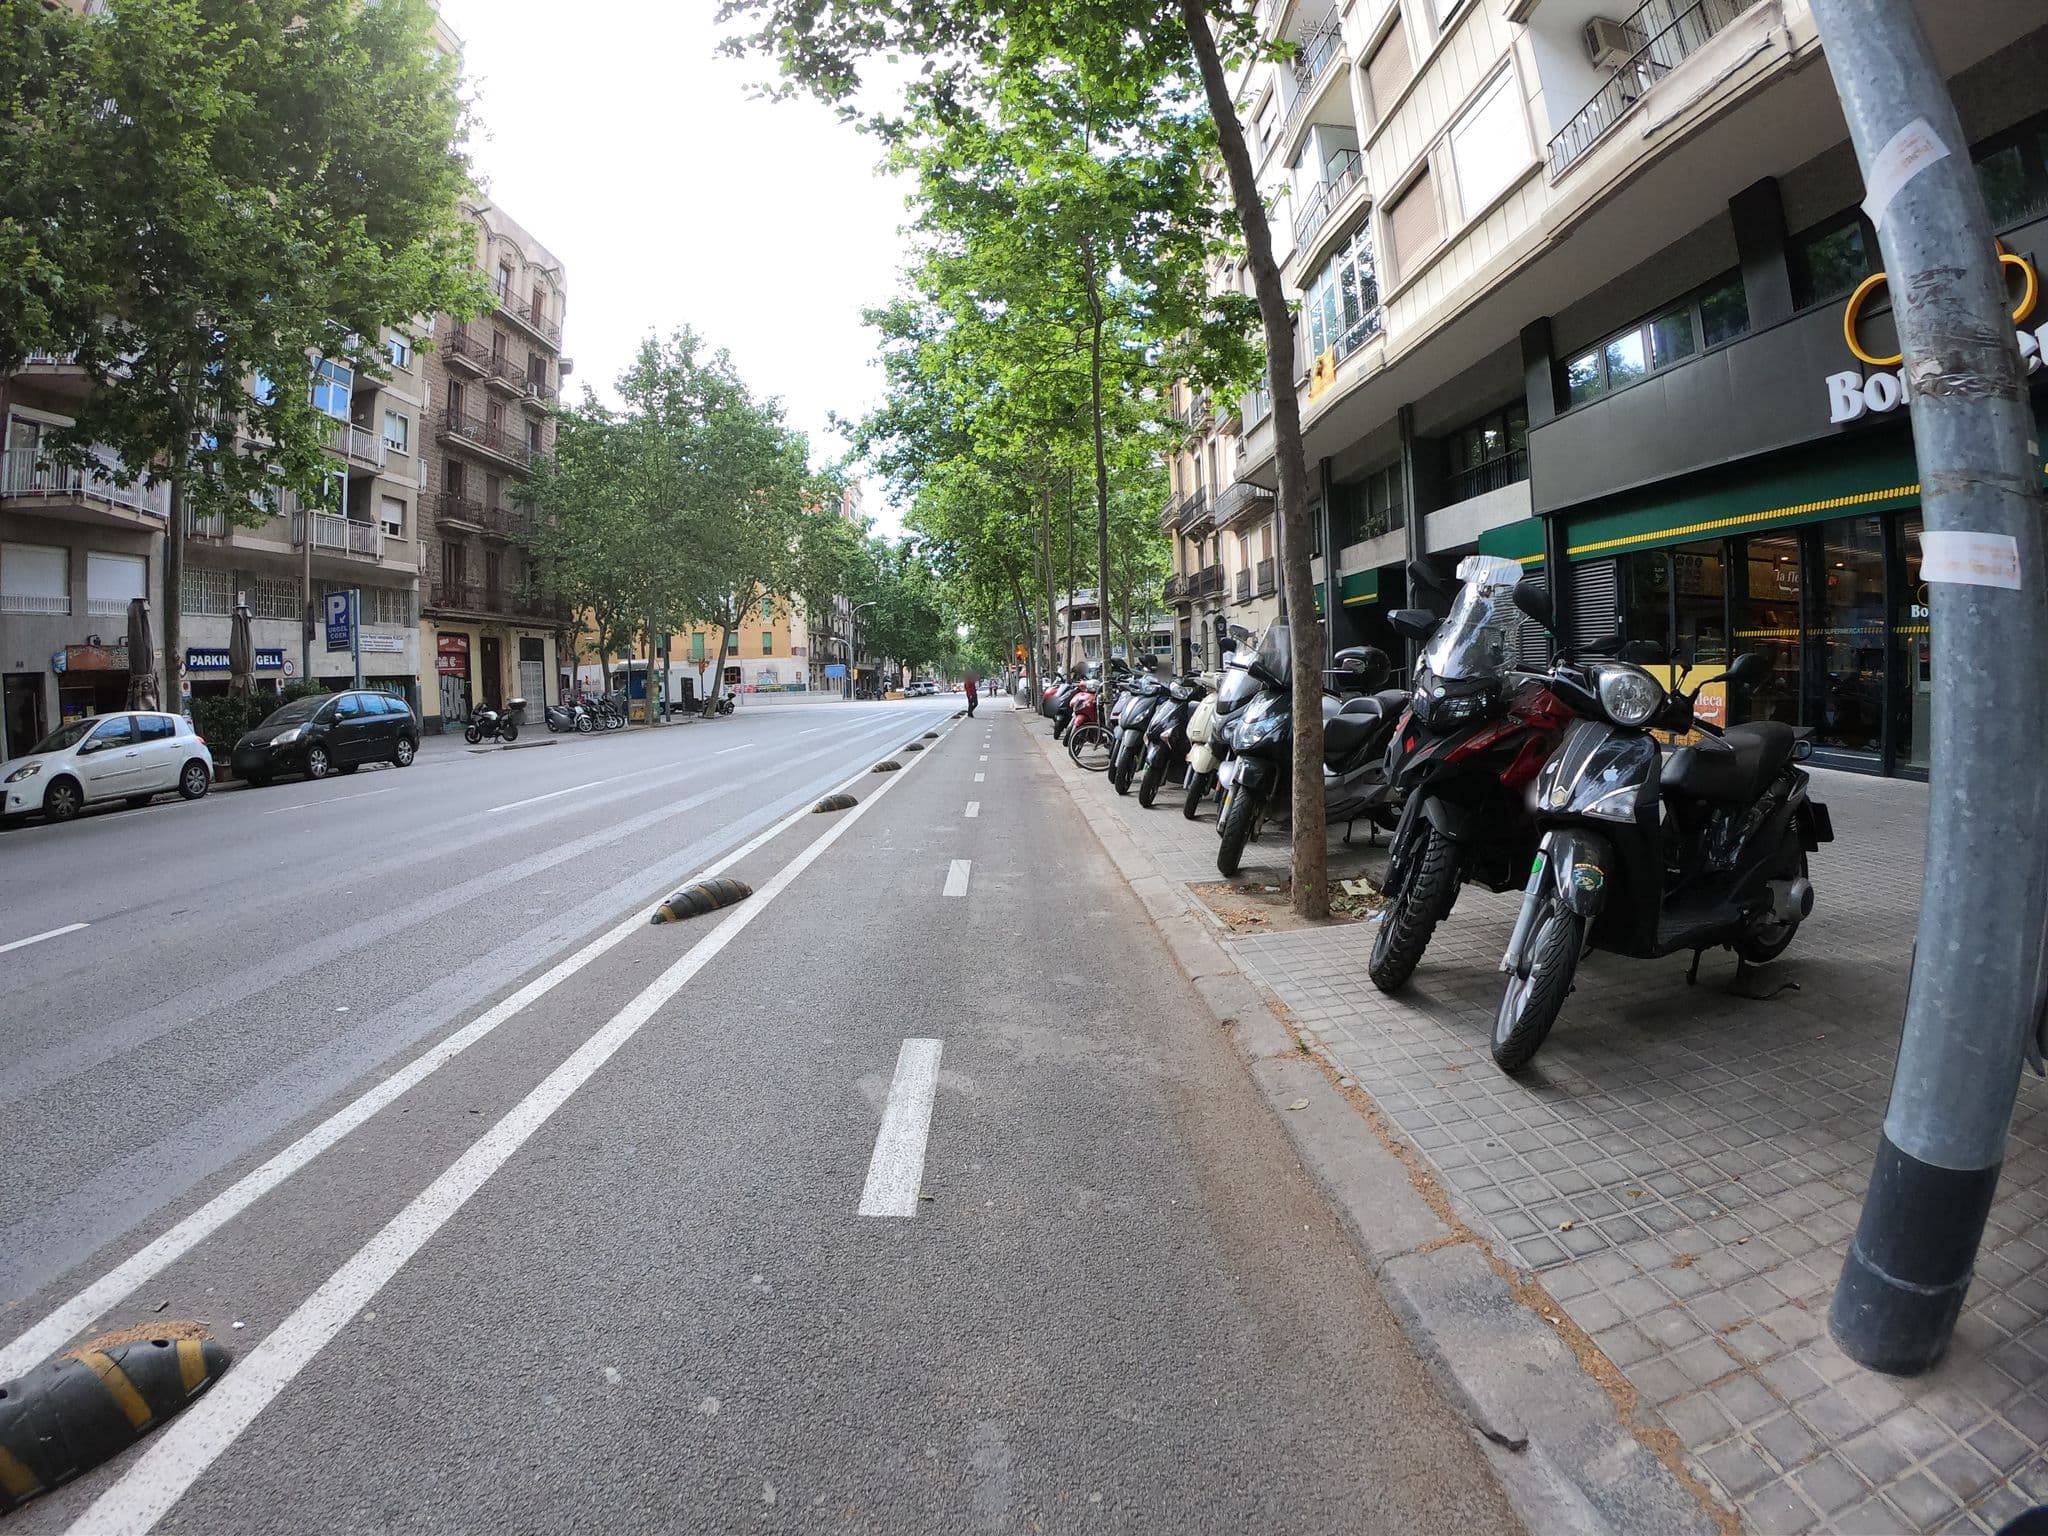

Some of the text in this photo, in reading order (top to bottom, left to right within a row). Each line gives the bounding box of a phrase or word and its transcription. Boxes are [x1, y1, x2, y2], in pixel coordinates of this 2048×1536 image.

[327, 595, 346, 625] P
[190, 655, 281, 666] PARKIN GELL
